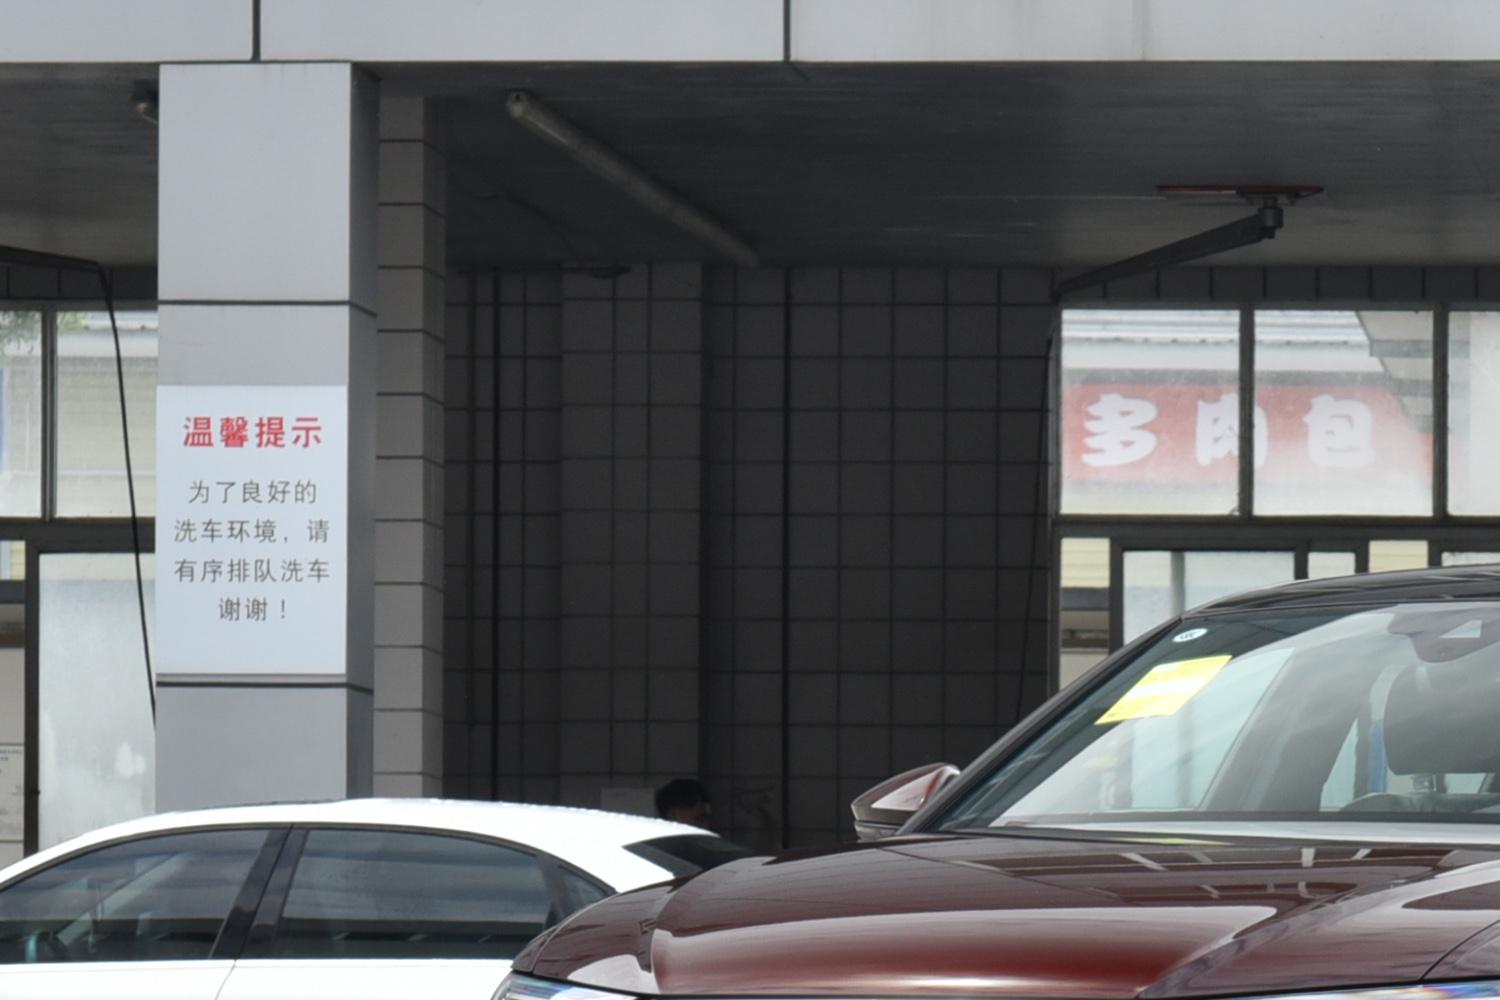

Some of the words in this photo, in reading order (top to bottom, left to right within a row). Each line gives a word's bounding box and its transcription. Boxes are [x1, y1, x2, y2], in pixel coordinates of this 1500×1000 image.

[183, 416, 322, 449] 温馨提示
[1081, 393, 1376, 468] 多肉包
[188, 480, 317, 504] 为了良好的
[173, 559, 331, 584] 有序排队洗车
[218, 597, 287, 622] 谢谢！
